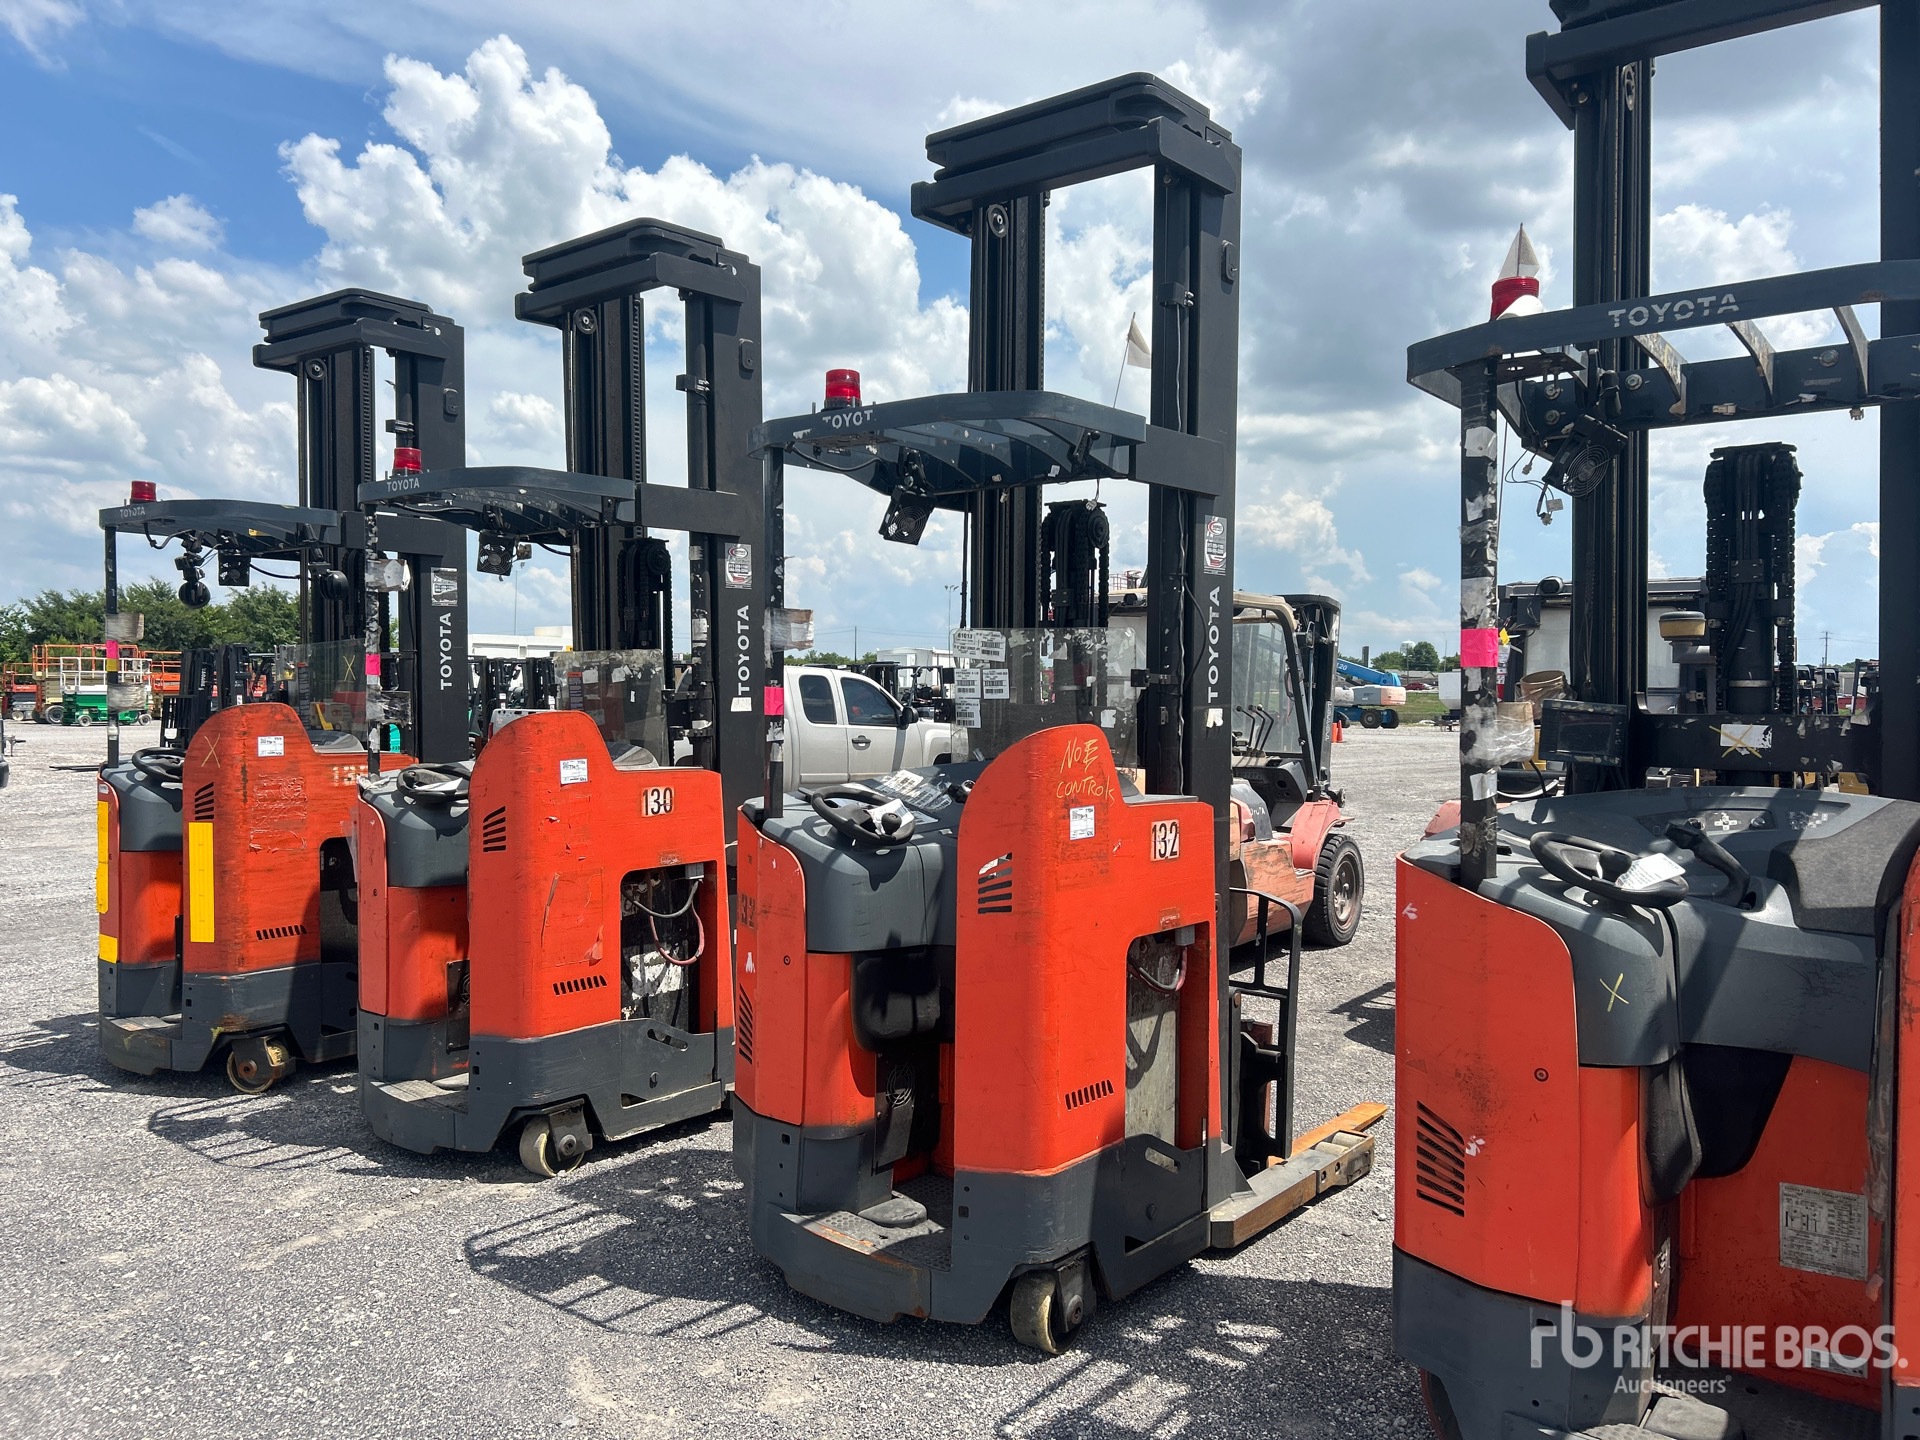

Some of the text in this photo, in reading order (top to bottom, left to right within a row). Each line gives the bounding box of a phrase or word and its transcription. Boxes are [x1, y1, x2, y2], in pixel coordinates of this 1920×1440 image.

[1608, 293, 1740, 328] TOYOTA
[386, 477, 420, 492] TOYOTA
[439, 612, 453, 691] TOYOTA
[737, 604, 750, 696] TOYOTA
[1207, 585, 1221, 704] TOYOTA
[642, 787, 673, 816] 130
[1152, 821, 1179, 860] 132
